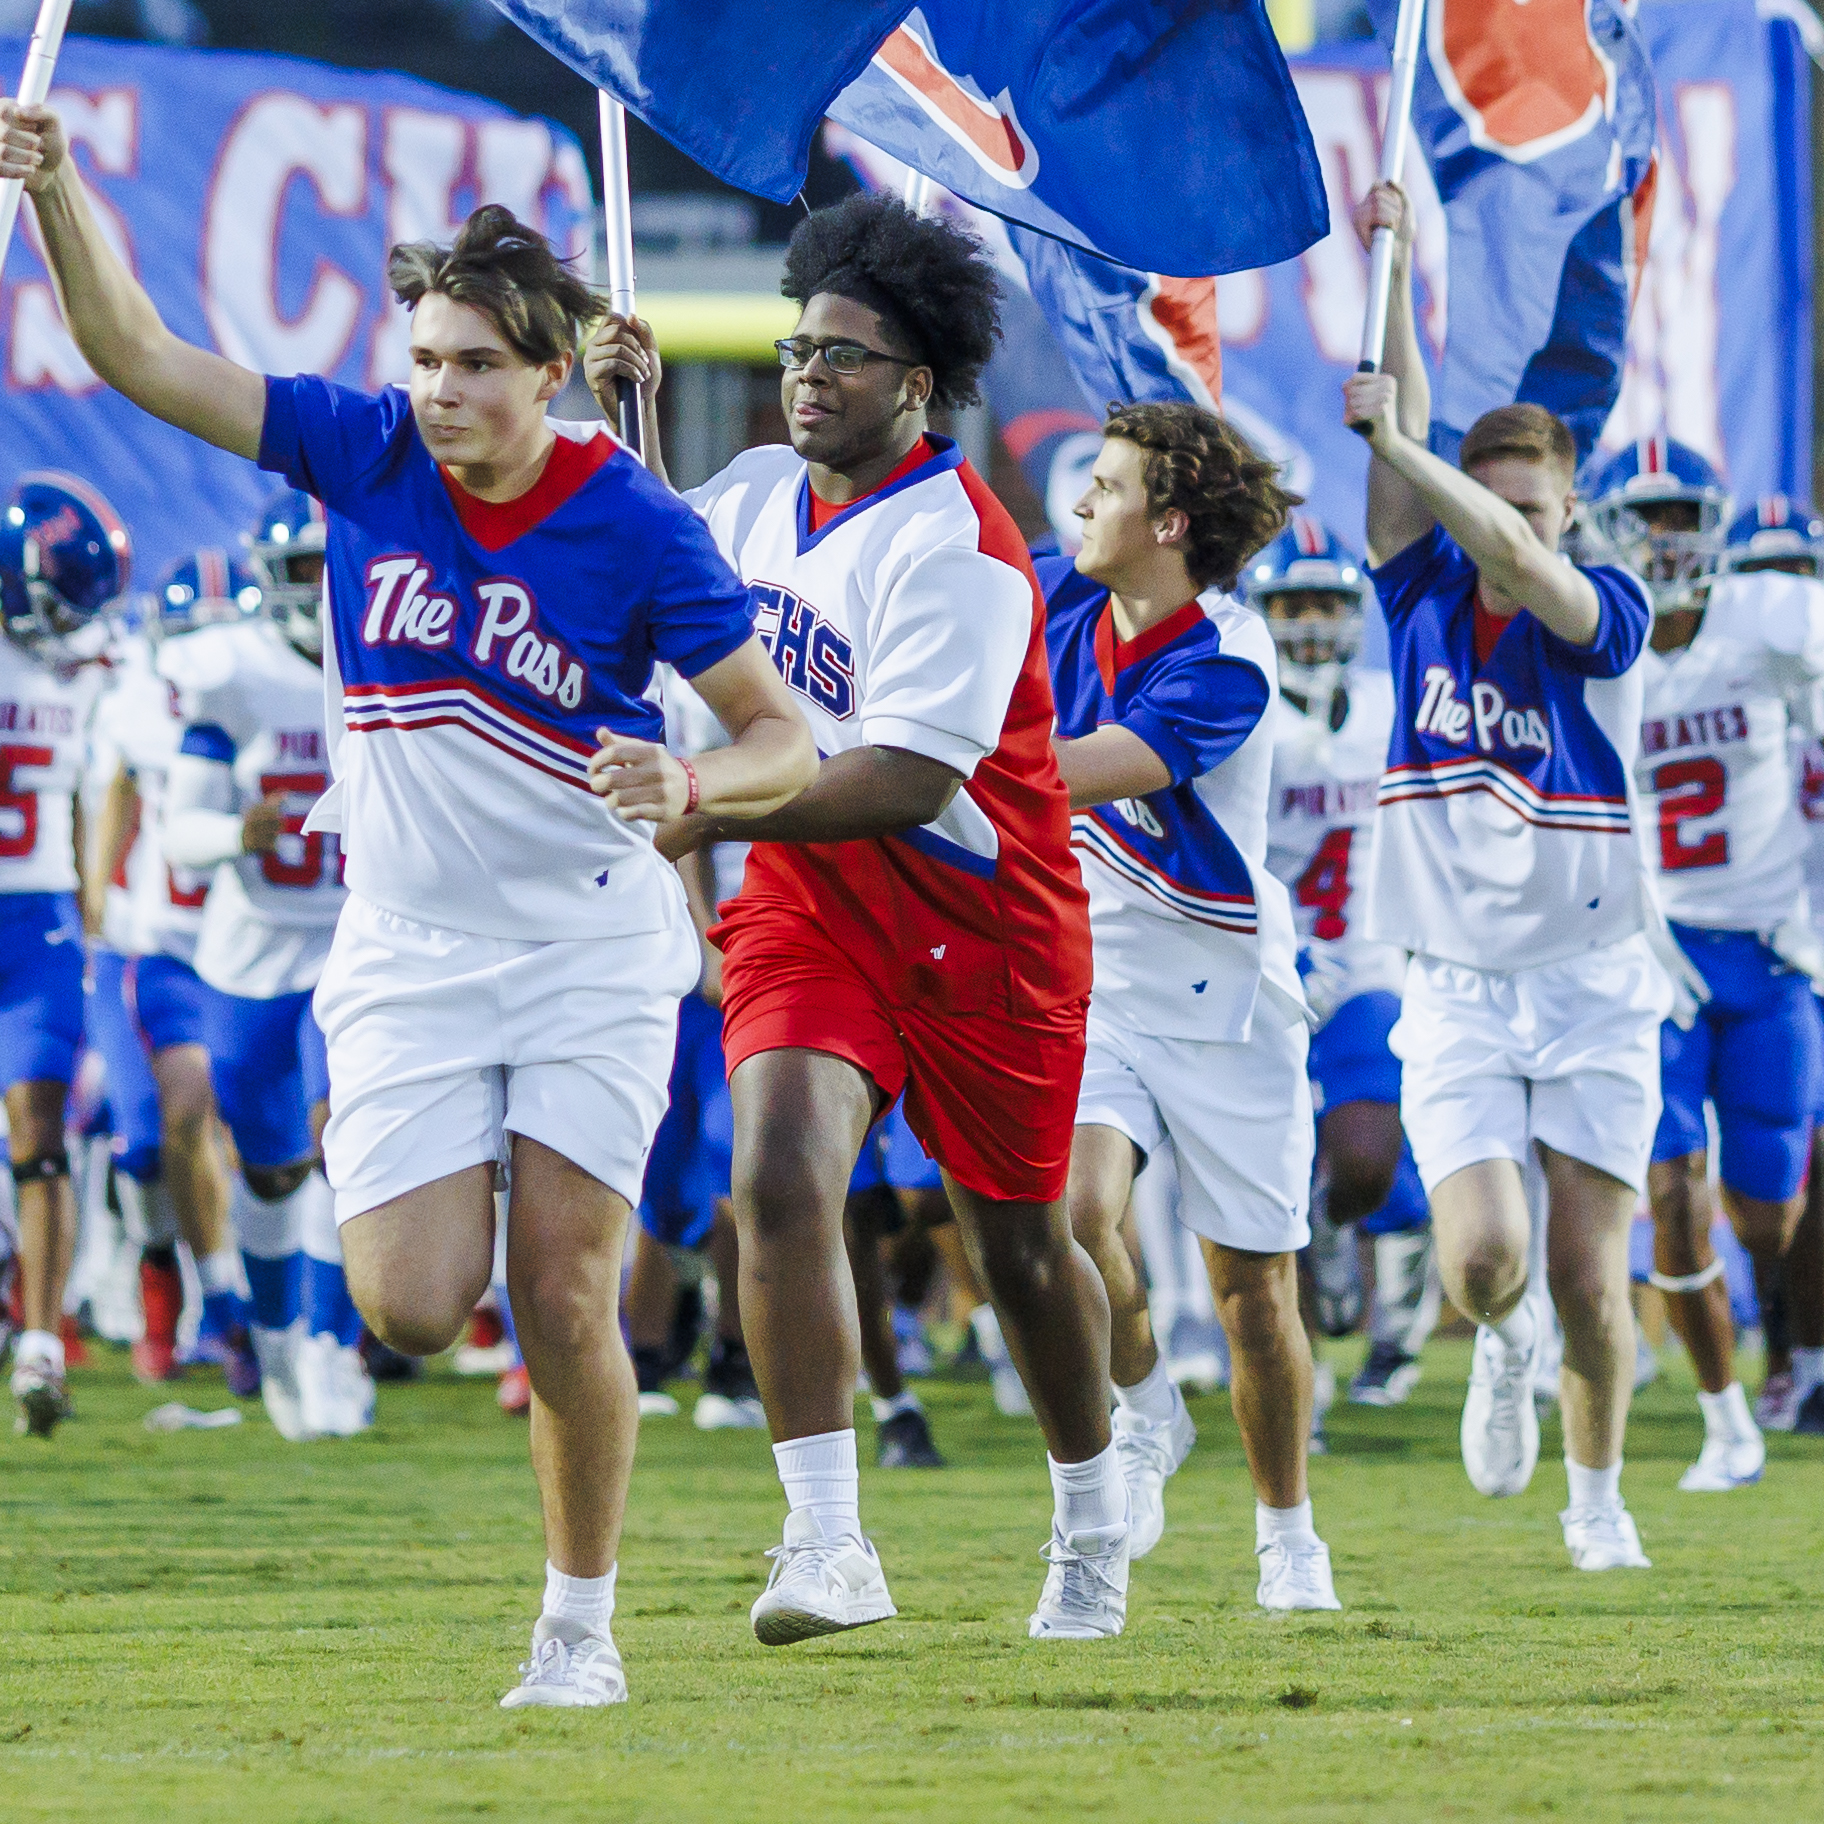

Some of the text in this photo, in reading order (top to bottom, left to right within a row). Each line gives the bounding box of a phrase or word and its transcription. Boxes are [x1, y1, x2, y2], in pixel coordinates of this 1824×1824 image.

[198, 86, 596, 394] CH
[362, 554, 586, 710] The Pass
[1414, 665, 1553, 758] The Pas
[1642, 706, 1749, 754] IRATES
[1654, 756, 1730, 872] 2
[1295, 827, 1353, 941] 4
